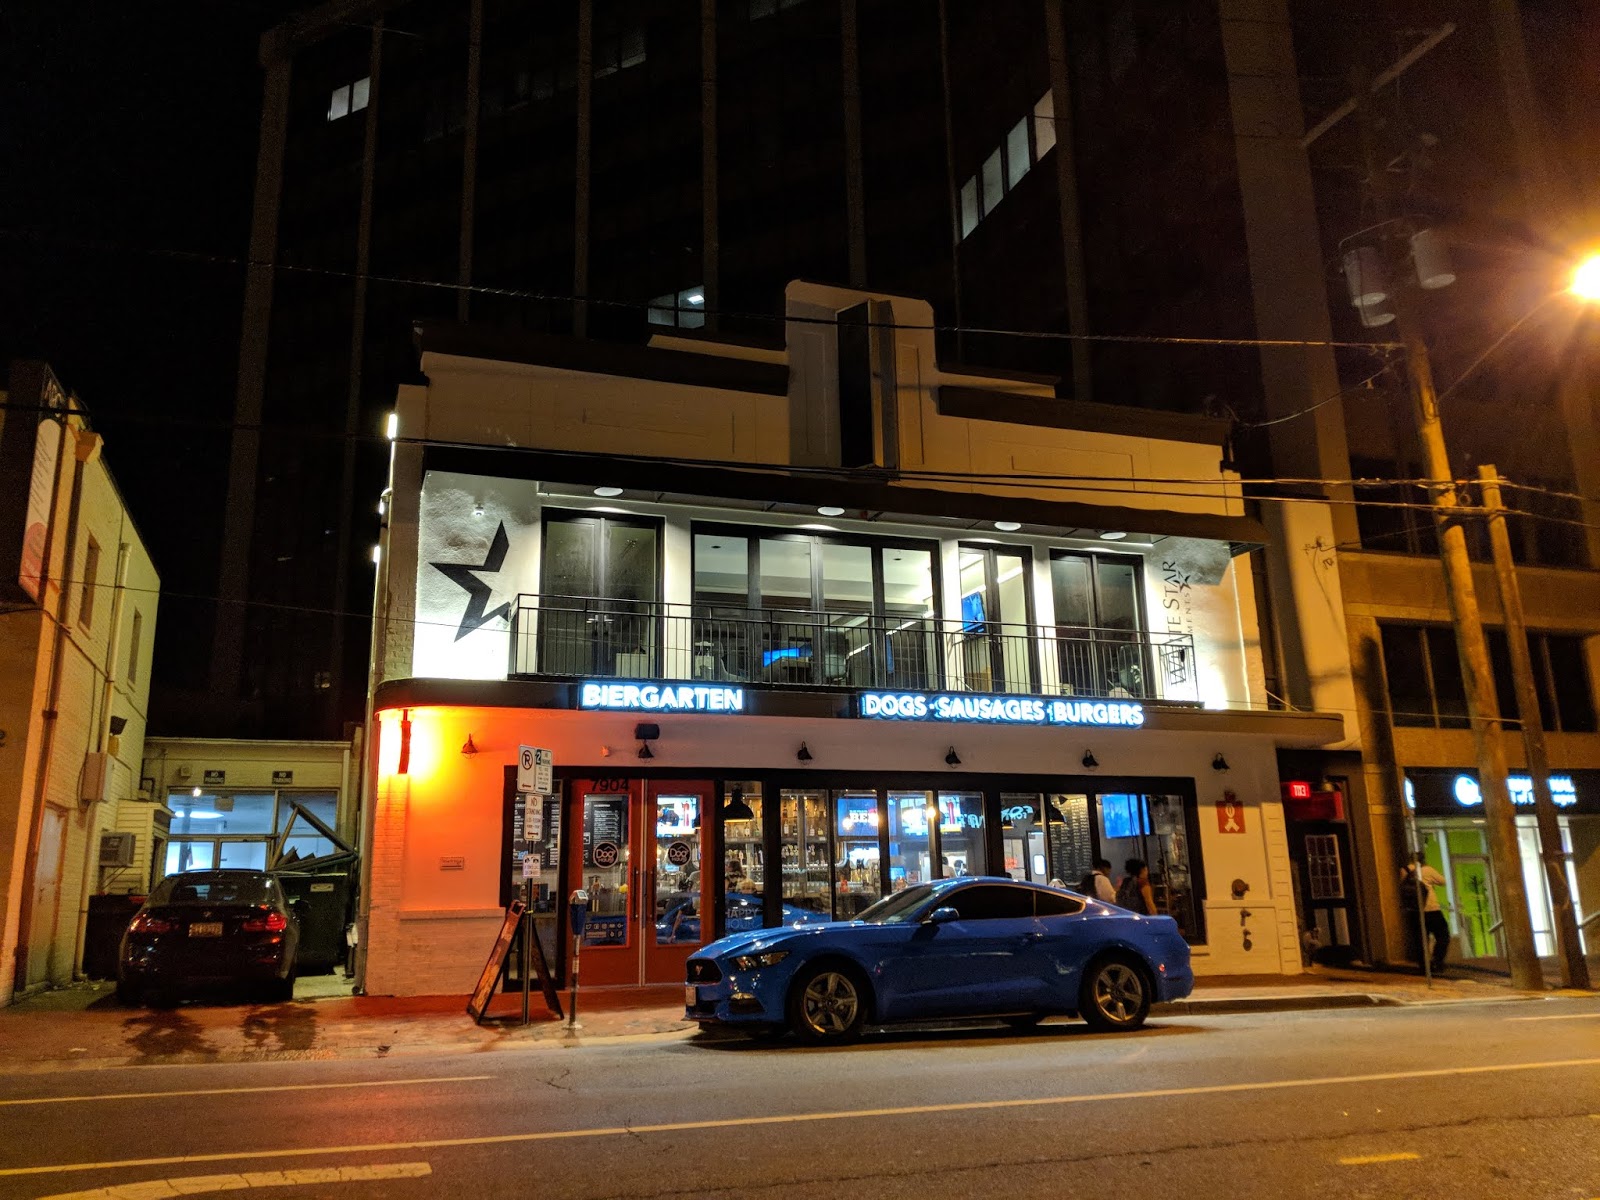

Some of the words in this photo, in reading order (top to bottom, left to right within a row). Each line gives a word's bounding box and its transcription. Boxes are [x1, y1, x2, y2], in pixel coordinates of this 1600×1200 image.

[1162, 561, 1179, 610] STAR
[582, 684, 743, 709] BIERGARTEN
[862, 693, 927, 718] DOGS
[934, 696, 1046, 722] SAUSAGES
[1053, 700, 1145, 727] BURGERS
[591, 778, 629, 792] 7904
[531, 797, 538, 807] NO
